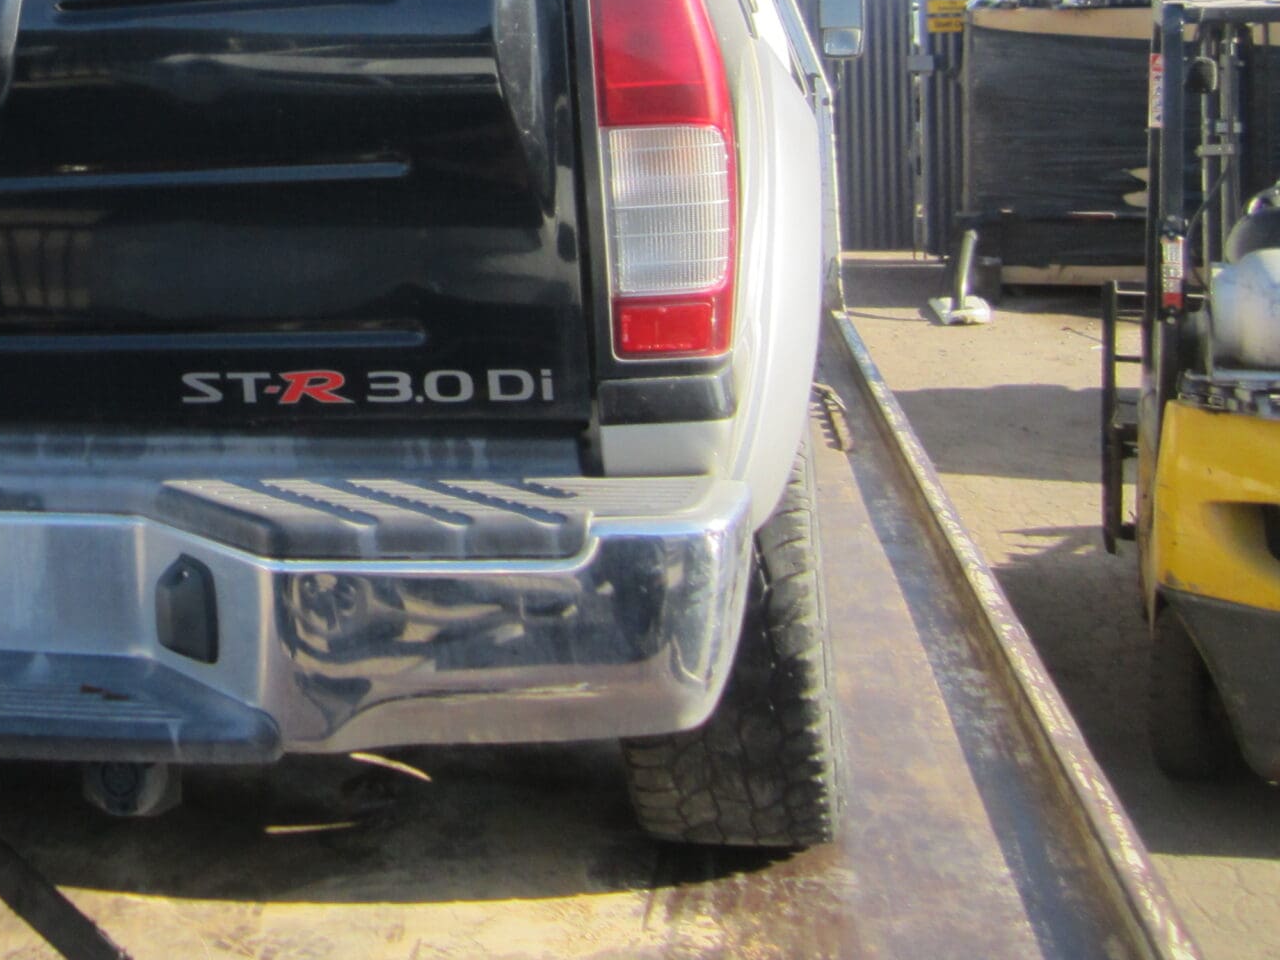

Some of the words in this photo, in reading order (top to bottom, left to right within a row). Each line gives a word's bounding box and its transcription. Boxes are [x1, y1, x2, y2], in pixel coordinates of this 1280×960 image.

[181, 369, 355, 404] ST-R
[366, 369, 474, 403] 3.0
[486, 368, 554, 402] Di
